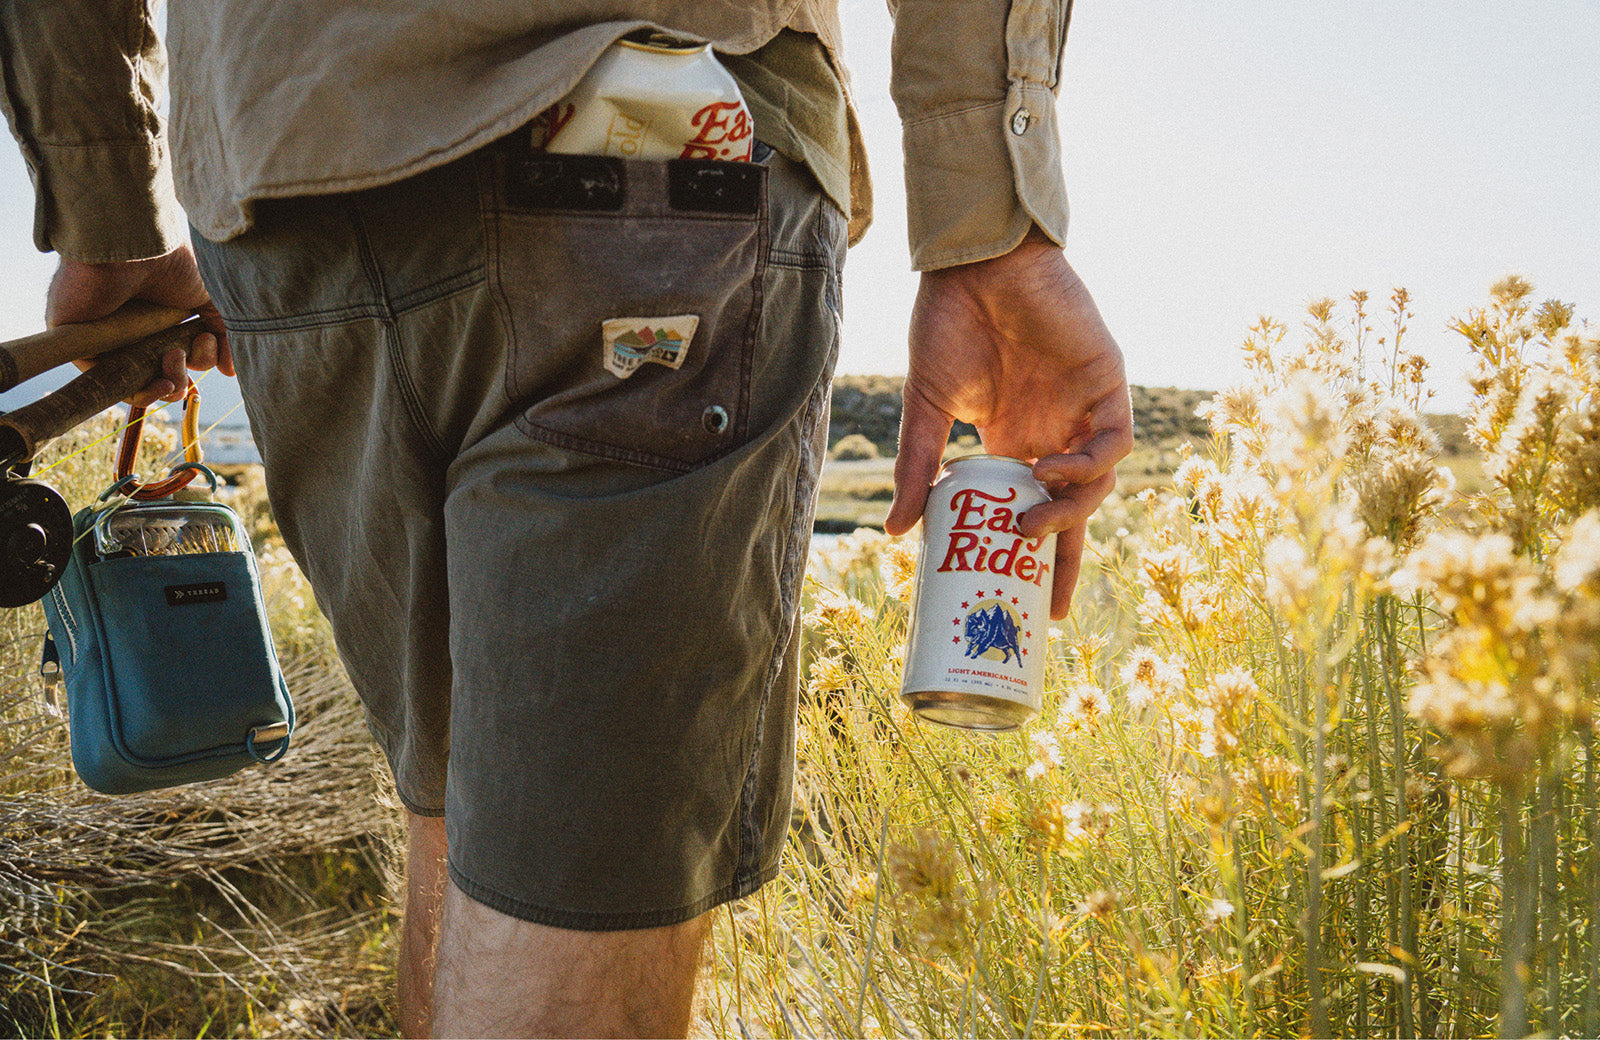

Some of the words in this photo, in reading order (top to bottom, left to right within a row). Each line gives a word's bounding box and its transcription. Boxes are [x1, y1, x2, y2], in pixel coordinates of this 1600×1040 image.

[689, 99, 752, 145] Ea
[937, 531, 1050, 587] Rider
[187, 588, 220, 596] THREAD
[971, 670, 1009, 681] AMERICAN
